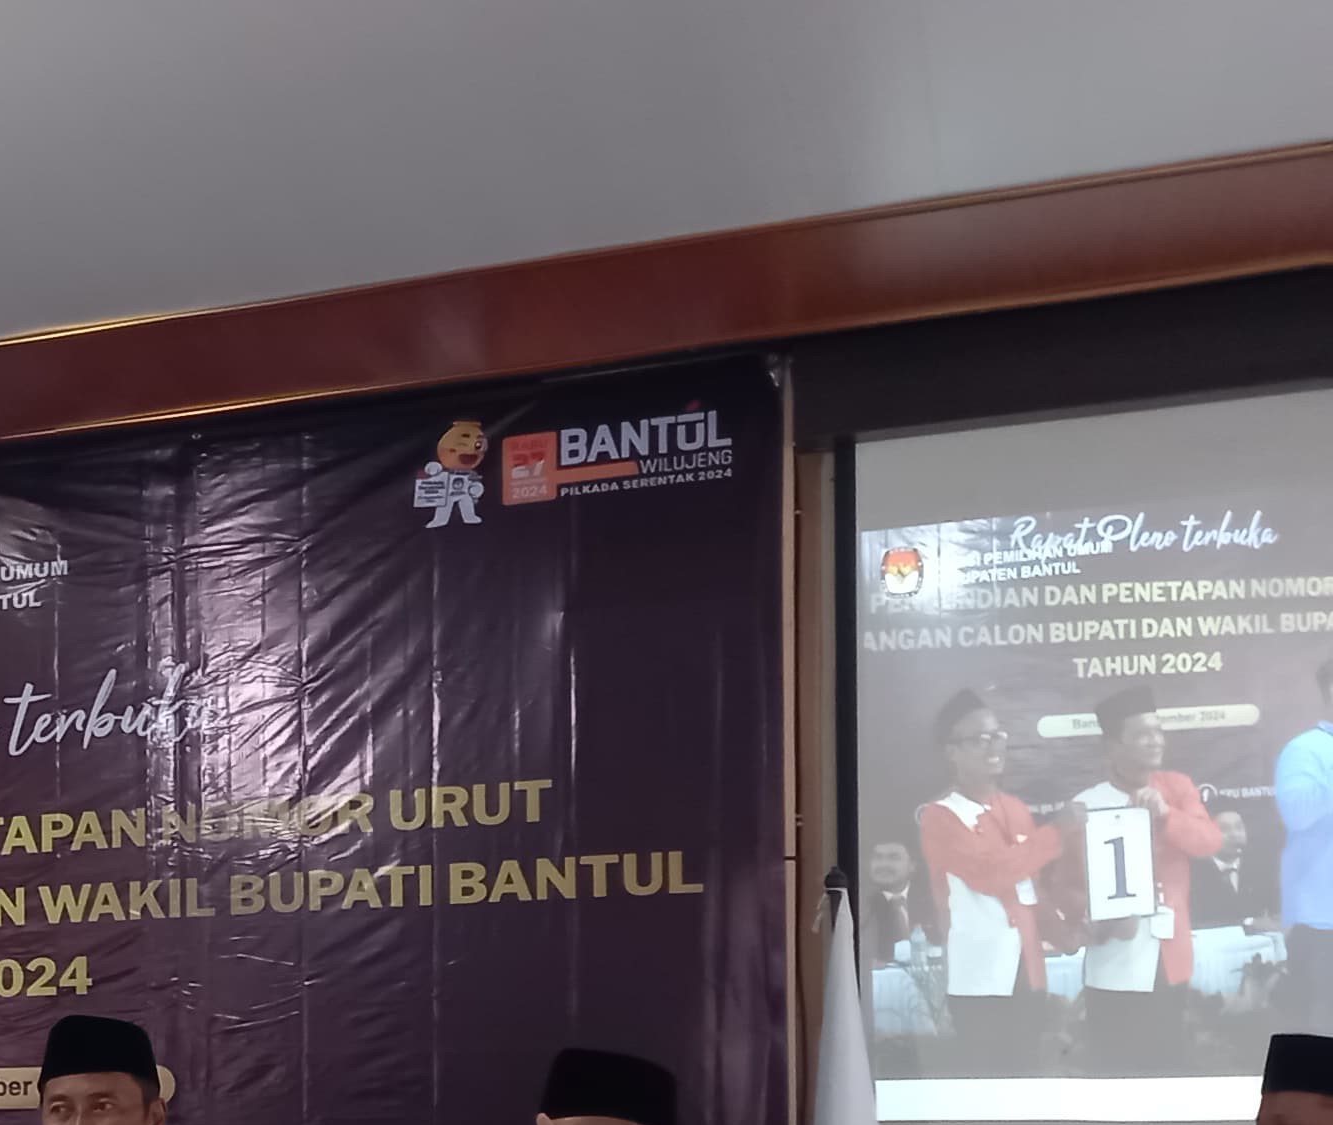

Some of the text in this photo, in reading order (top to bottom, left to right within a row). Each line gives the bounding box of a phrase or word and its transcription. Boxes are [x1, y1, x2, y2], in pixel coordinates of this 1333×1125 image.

[639, 450, 732, 473] WILUJENG
[512, 485, 547, 498] 2024
[560, 467, 733, 497] PILKADA SERENTAK 2024
[1097, 512, 1179, 551] Pleno
[1181, 510, 1279, 551] terbuka
[0, 559, 69, 583] UMUM
[1020, 562, 1081, 579] BANTUL
[1044, 584, 1096, 606] DAN
[1101, 579, 1246, 605] PENETAPAN
[958, 623, 1043, 648] CALON
[1049, 619, 1137, 643] BUPATI
[1141, 617, 1193, 638] DAN
[1196, 614, 1275, 637] WAKIL
[1073, 651, 1223, 678] TAHUN 2024
[389, 779, 553, 831] URUT
[1103, 836, 1137, 901] 1
[38, 877, 215, 923] WAKIL
[230, 863, 434, 917] BUPATI
[450, 850, 704, 905] BANTUL
